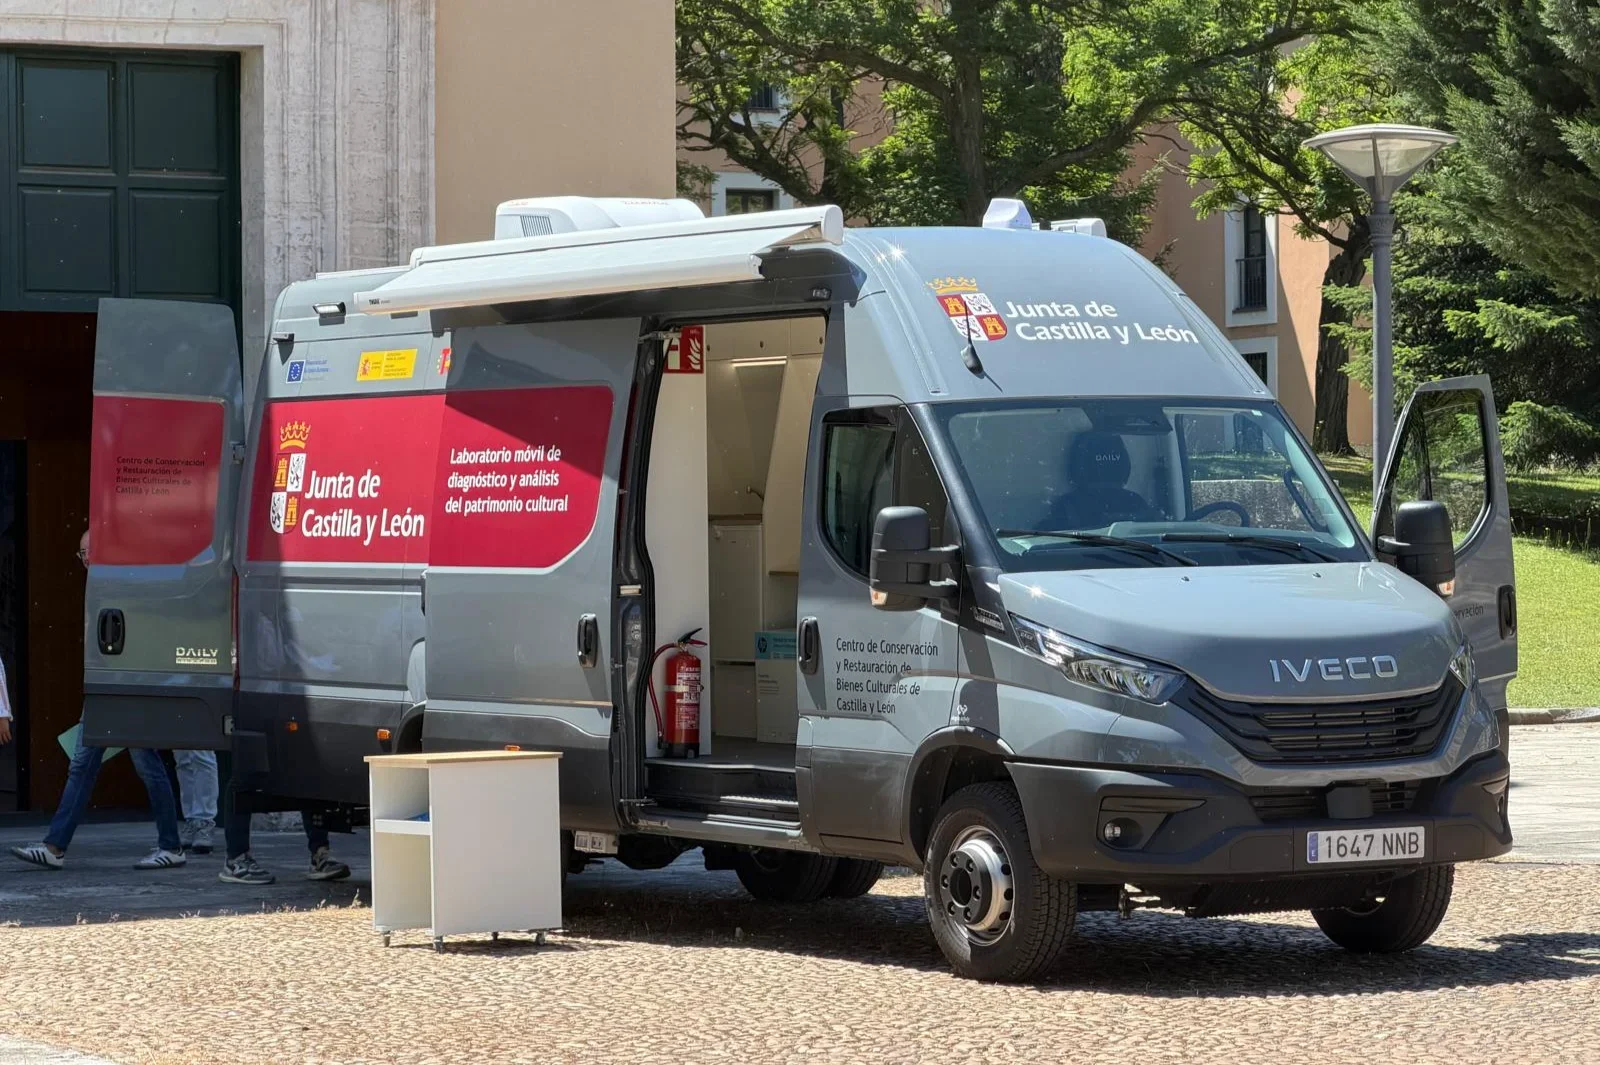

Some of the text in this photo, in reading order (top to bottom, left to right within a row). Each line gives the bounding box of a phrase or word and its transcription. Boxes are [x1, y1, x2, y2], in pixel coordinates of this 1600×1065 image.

[1006, 301, 1118, 318] Junta de
[1015, 322, 1199, 345] Castilla y León
[117, 456, 205, 467] Centro de Conservación
[450, 445, 561, 464] Laboratorio móvil de
[116, 466, 182, 475] y Restauración de
[304, 468, 380, 499] Junta de
[447, 470, 559, 493] diagnóstico y análisis
[445, 494, 568, 517] del patrimonio cultural
[301, 507, 425, 546] Castilla y León
[176, 646, 218, 657] DAILY
[836, 637, 939, 656] Centro de Conservación
[836, 658, 912, 674] y Restauración de
[1269, 655, 1398, 682] IVECO
[836, 677, 920, 695] Bienes Culturales de
[836, 697, 896, 714] Castilla y León
[1326, 832, 1419, 859] 1647 NNB
